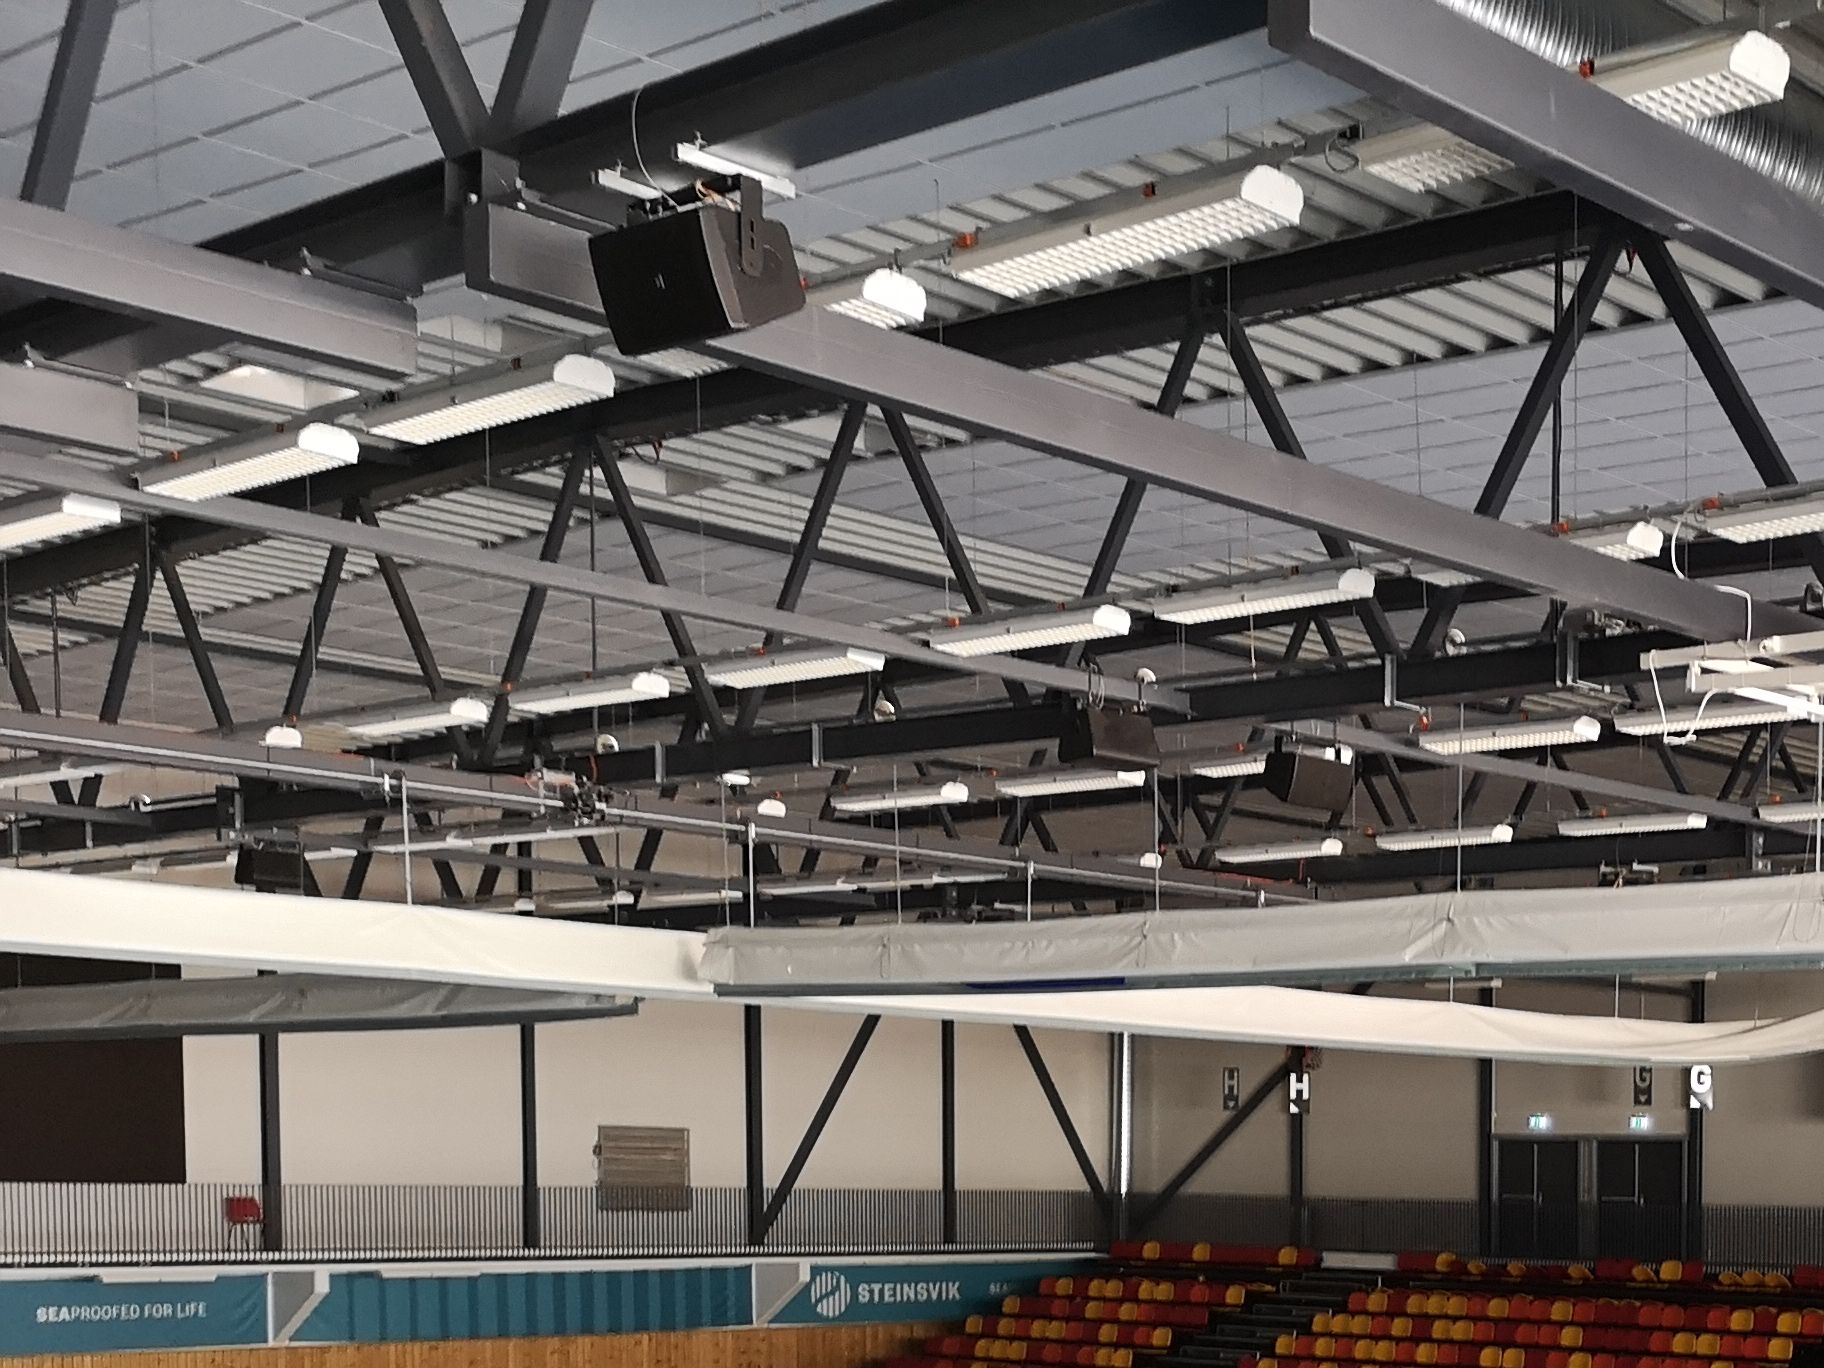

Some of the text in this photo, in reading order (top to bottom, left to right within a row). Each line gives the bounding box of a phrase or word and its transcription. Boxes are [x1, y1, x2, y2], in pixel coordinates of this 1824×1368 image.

[1225, 1069, 1238, 1096] H
[1289, 1072, 1310, 1100] H
[1690, 1064, 1712, 1094] G
[858, 1281, 962, 1304] STEINSVIK
[36, 1301, 207, 1324] SEAPROOFED FOR LIFE
